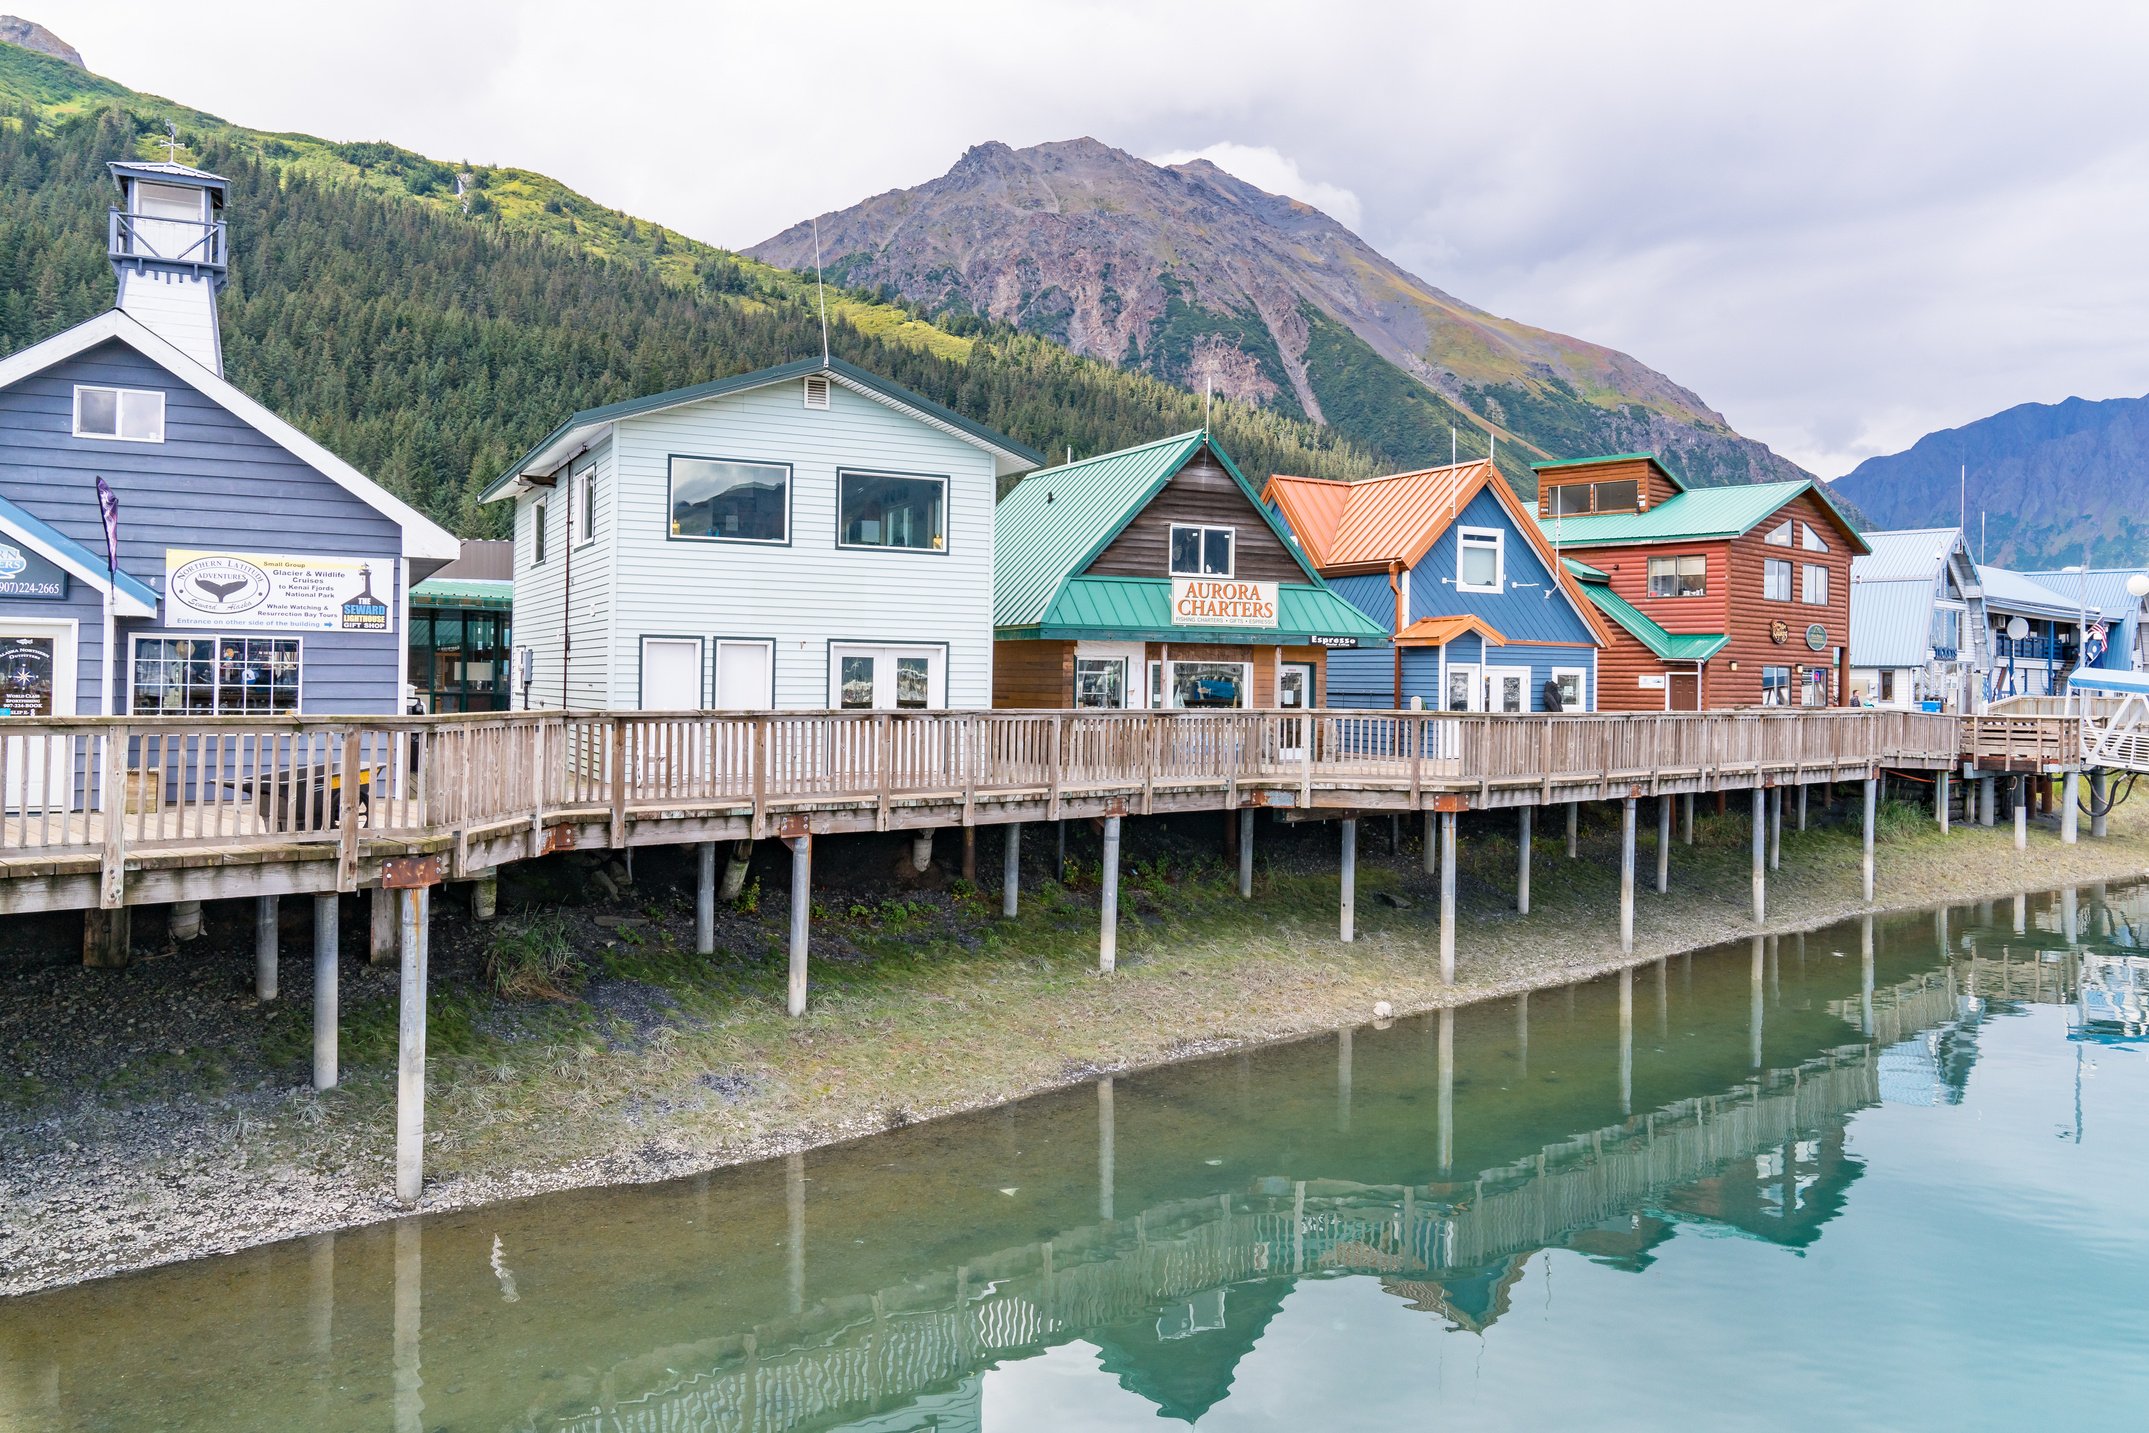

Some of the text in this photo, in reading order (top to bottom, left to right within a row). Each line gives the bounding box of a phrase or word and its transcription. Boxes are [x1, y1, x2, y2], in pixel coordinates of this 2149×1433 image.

[273, 569, 302, 577] Glacier
[1185, 582, 1261, 600] AURORA
[358, 597, 371, 605] THE
[344, 604, 385, 615] SEWARD
[1177, 599, 1273, 618] CHARTERS
[343, 614, 385, 623] LIGHTHOUSE
[1311, 635, 1356, 645] Espresso
